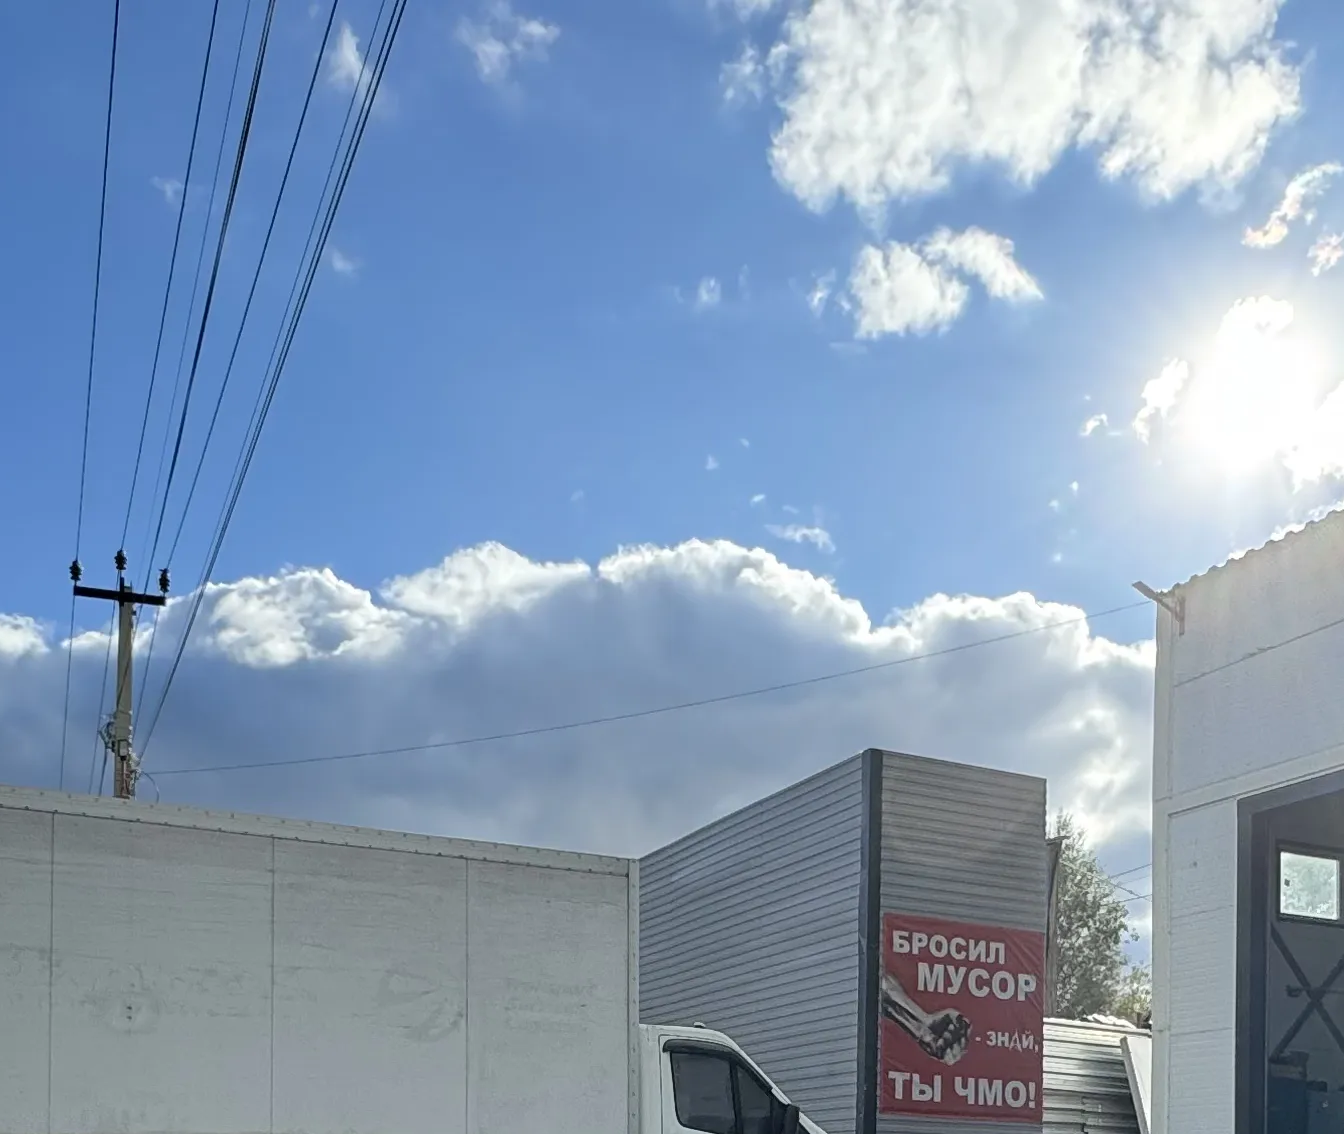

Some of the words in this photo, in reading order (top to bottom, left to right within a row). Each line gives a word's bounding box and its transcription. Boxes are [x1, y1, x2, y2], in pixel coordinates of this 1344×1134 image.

[892, 930, 1005, 964] БРОСИЛ
[917, 962, 1037, 1001] МУСОР
[888, 1071, 942, 1103] ТЫ
[954, 1076, 1036, 1109] ЧМО!
